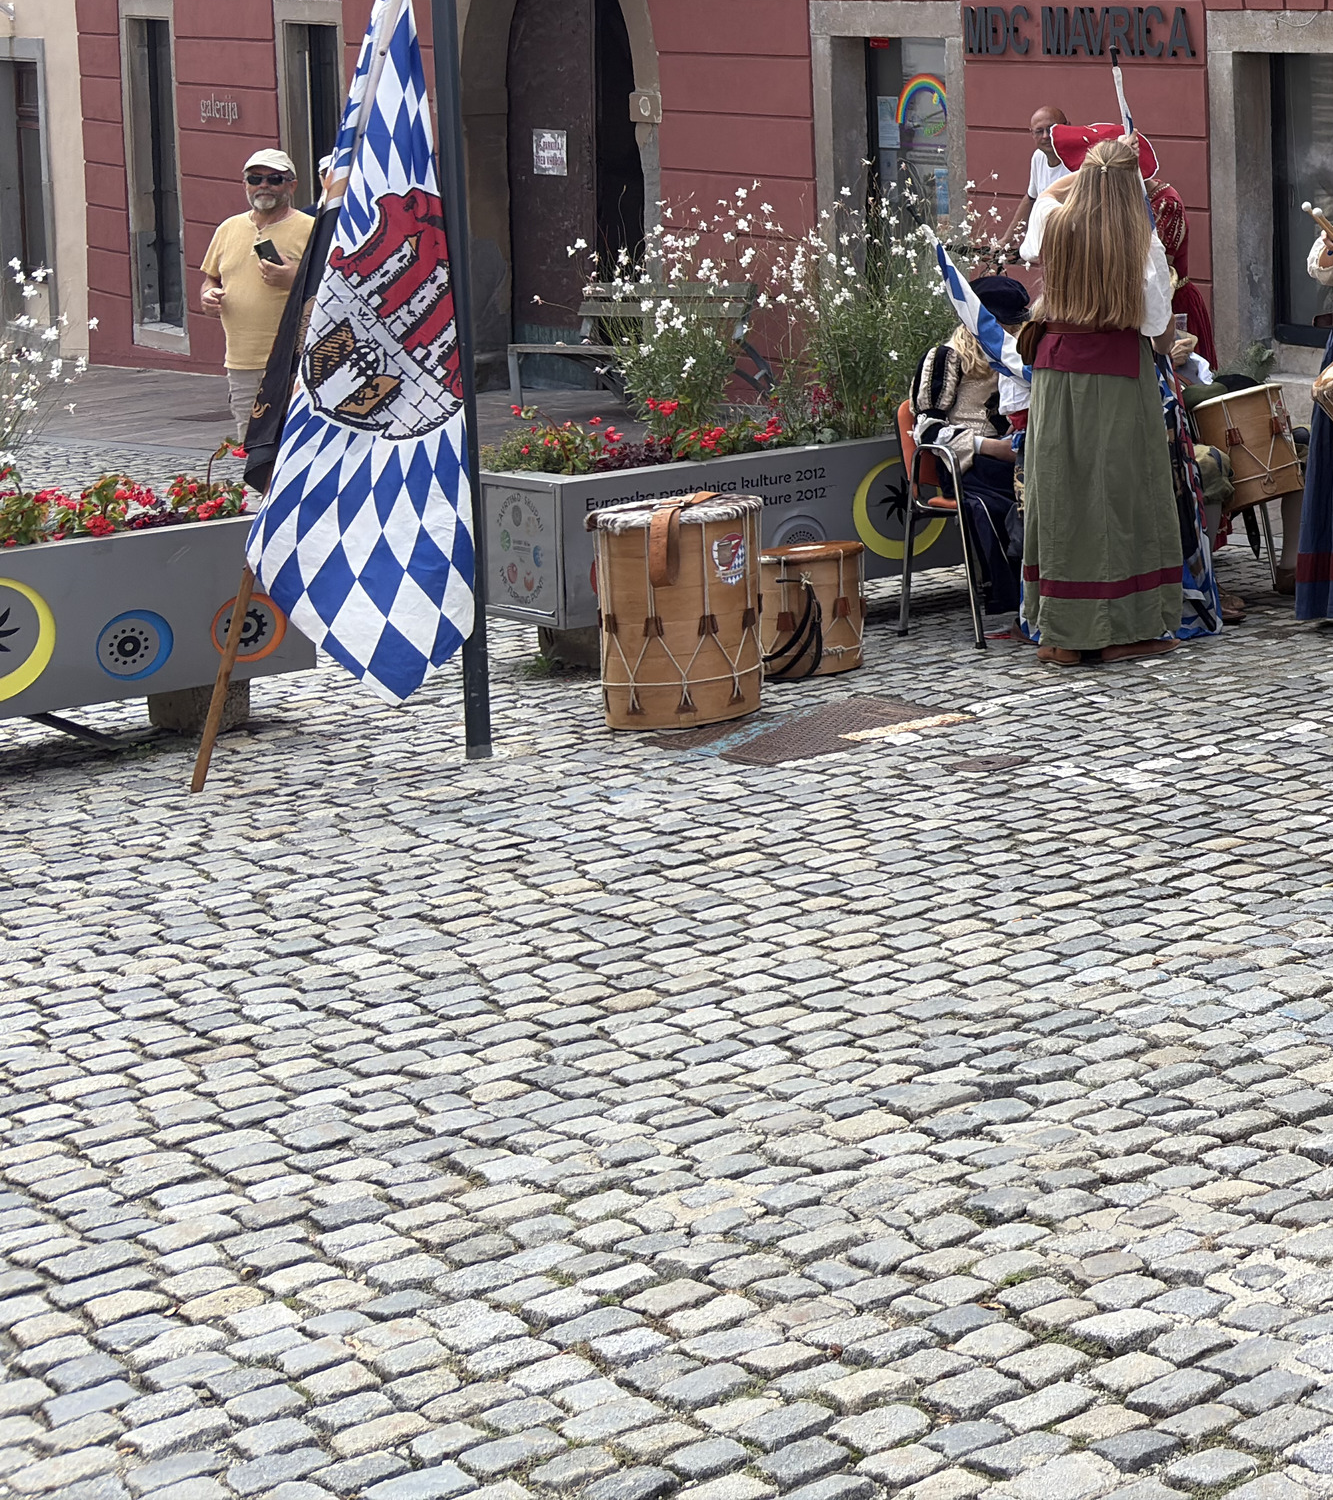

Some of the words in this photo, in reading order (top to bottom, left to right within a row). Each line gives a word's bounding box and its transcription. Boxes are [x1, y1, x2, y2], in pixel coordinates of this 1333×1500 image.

[964, 5, 1029, 55] MDC
[1041, 5, 1193, 57] MAVRICA
[200, 93, 238, 125] galerija
[741, 474, 792, 489] kulture
[795, 467, 826, 482] 2012
[796, 487, 827, 502] 2012
